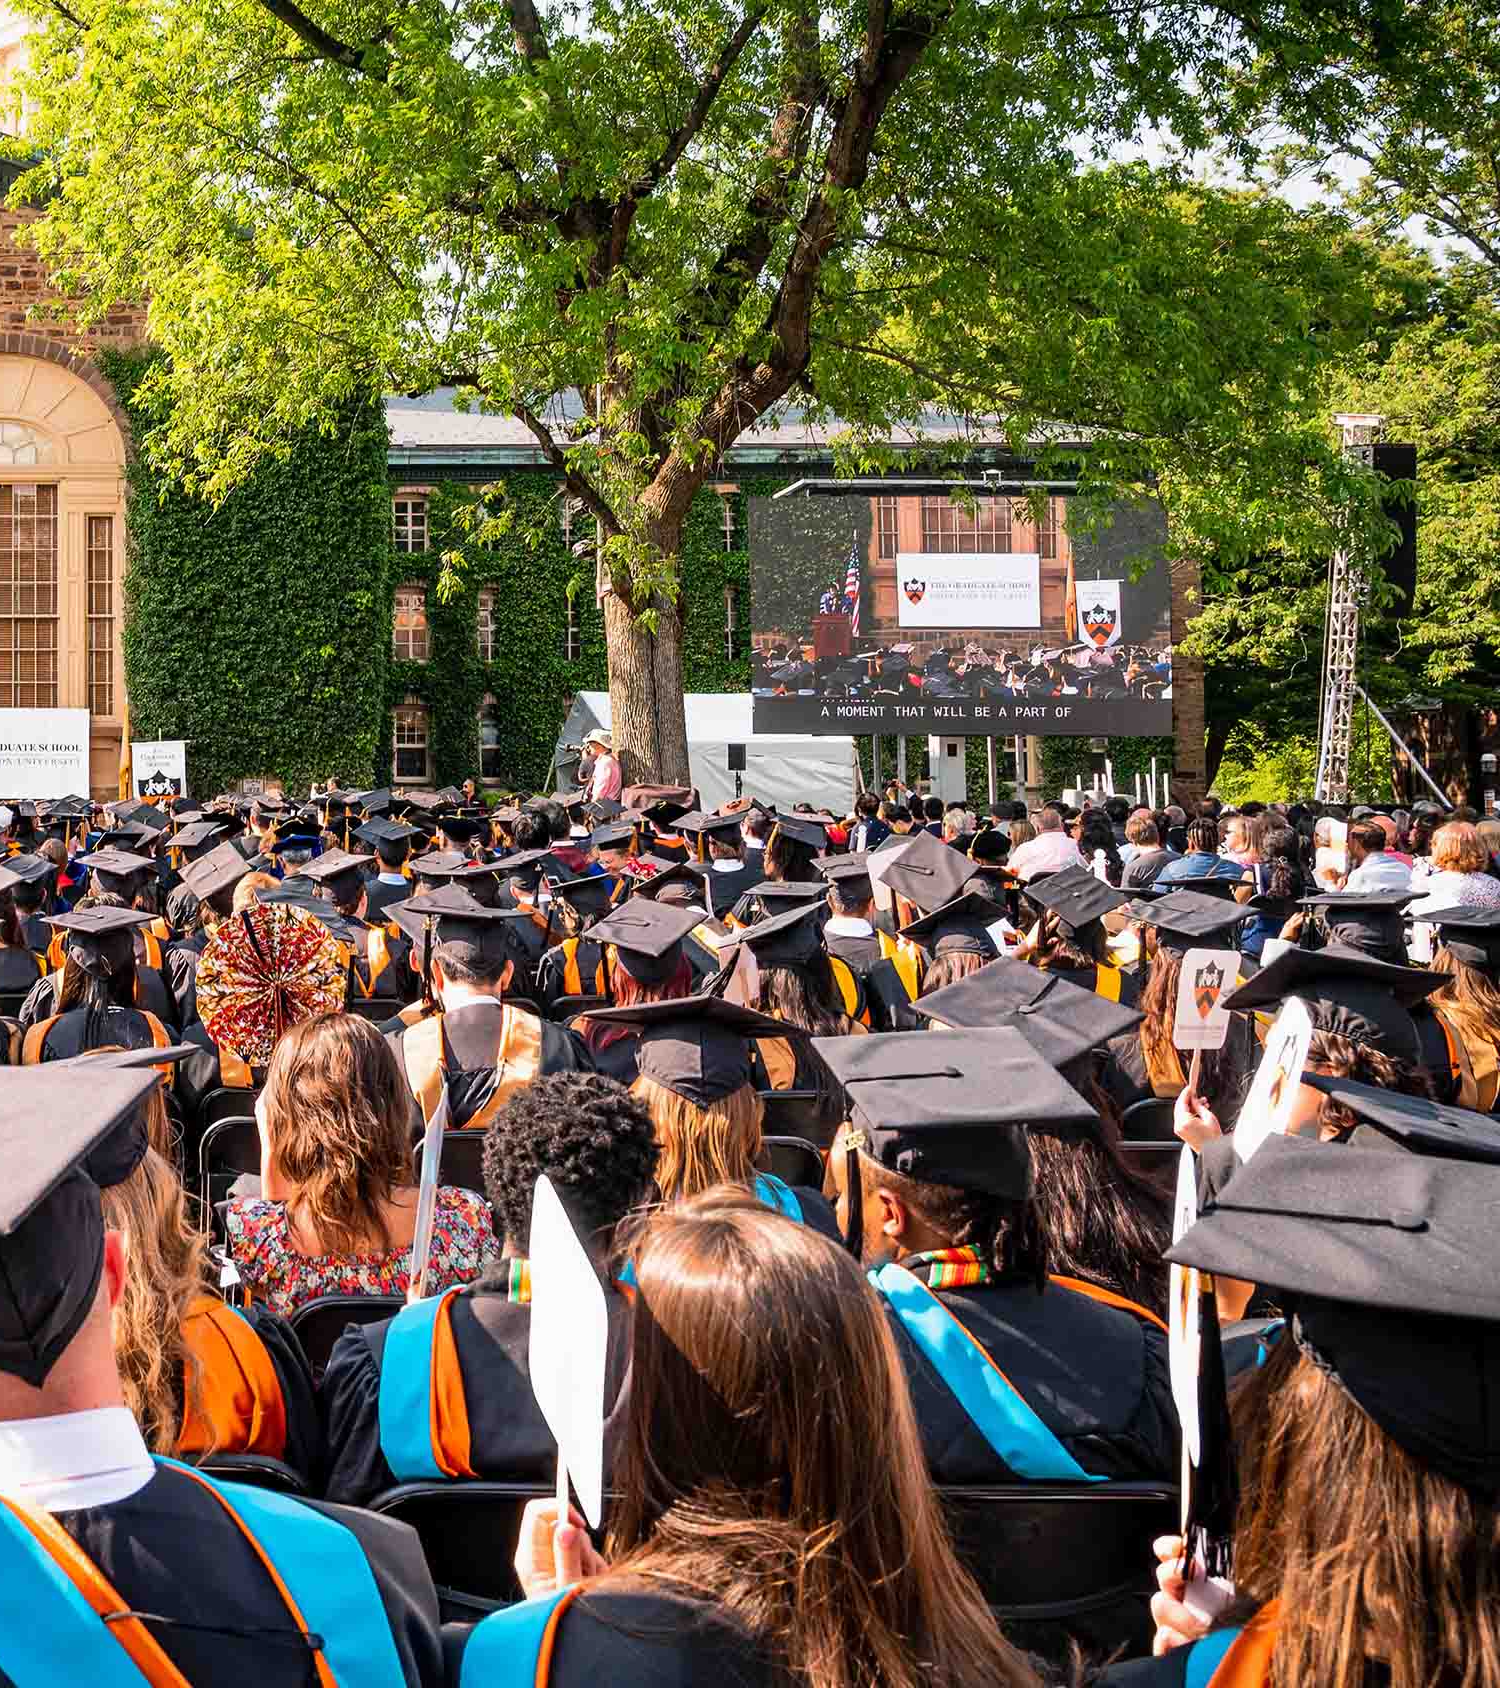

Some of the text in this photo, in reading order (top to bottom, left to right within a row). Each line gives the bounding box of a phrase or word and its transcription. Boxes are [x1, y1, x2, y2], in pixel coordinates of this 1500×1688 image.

[821, 706, 1072, 717] A MOMENT THAT WILL BE A PART OF
[38, 743, 83, 752] SCHOOL
